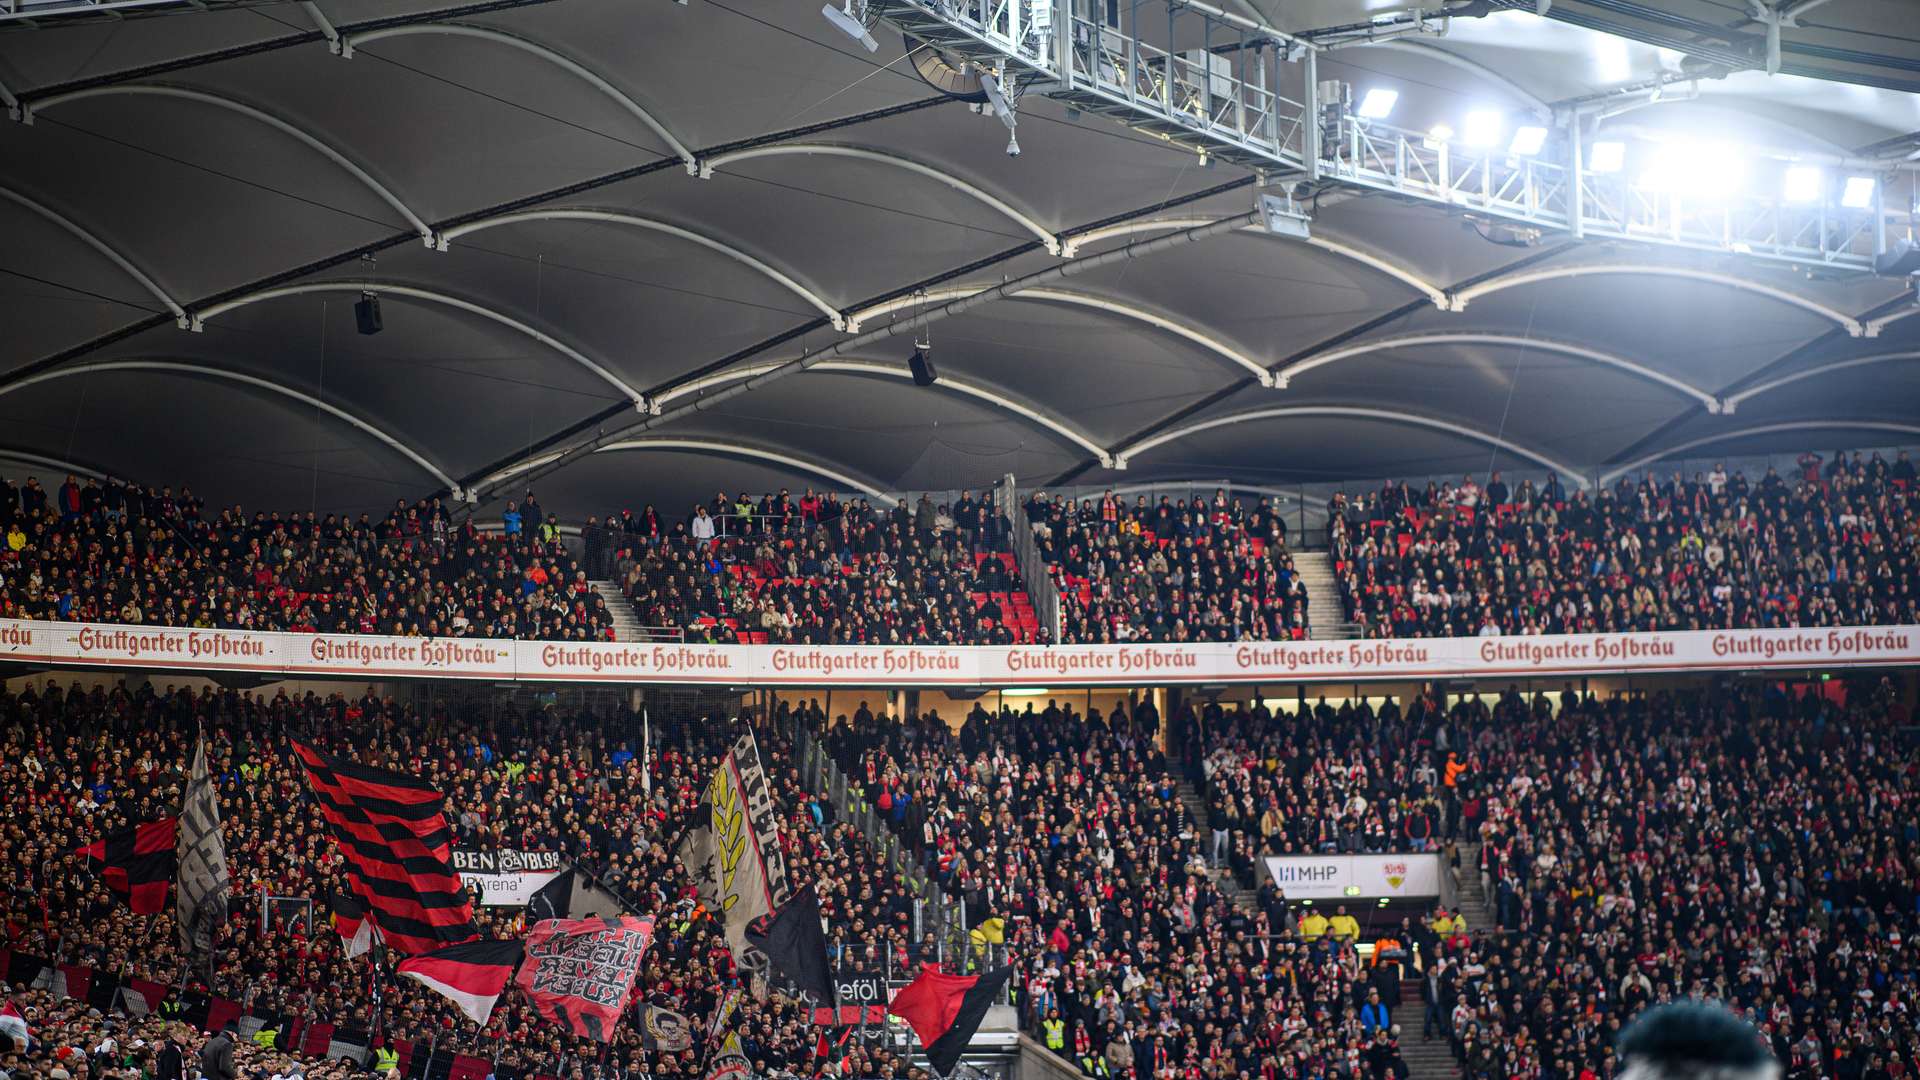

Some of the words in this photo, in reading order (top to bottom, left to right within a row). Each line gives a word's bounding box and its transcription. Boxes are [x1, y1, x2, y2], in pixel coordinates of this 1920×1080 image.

[79, 626, 184, 657] Stuttgarter
[188, 631, 264, 658] Hofbräu
[311, 637, 416, 666] Stuttgarter
[421, 639, 497, 666] Hofbräu
[1236, 645, 1344, 670] Stuttgarter
[1350, 642, 1428, 668] Hofbräu
[1481, 639, 1589, 665] Stuttgarter
[1595, 636, 1675, 661] Hofbräu
[1713, 633, 1822, 658] Stuttgarter
[1828, 629, 1909, 655] Hofbräu
[542, 644, 648, 672] Stuttgarter
[653, 646, 729, 672] Hofbräu
[772, 648, 878, 674] Stuttgarter
[883, 649, 960, 674] Hofbräu
[1007, 648, 1113, 674] Stuttgarter
[1119, 647, 1197, 672] Hofbräu
[1299, 865, 1337, 881] MHP
